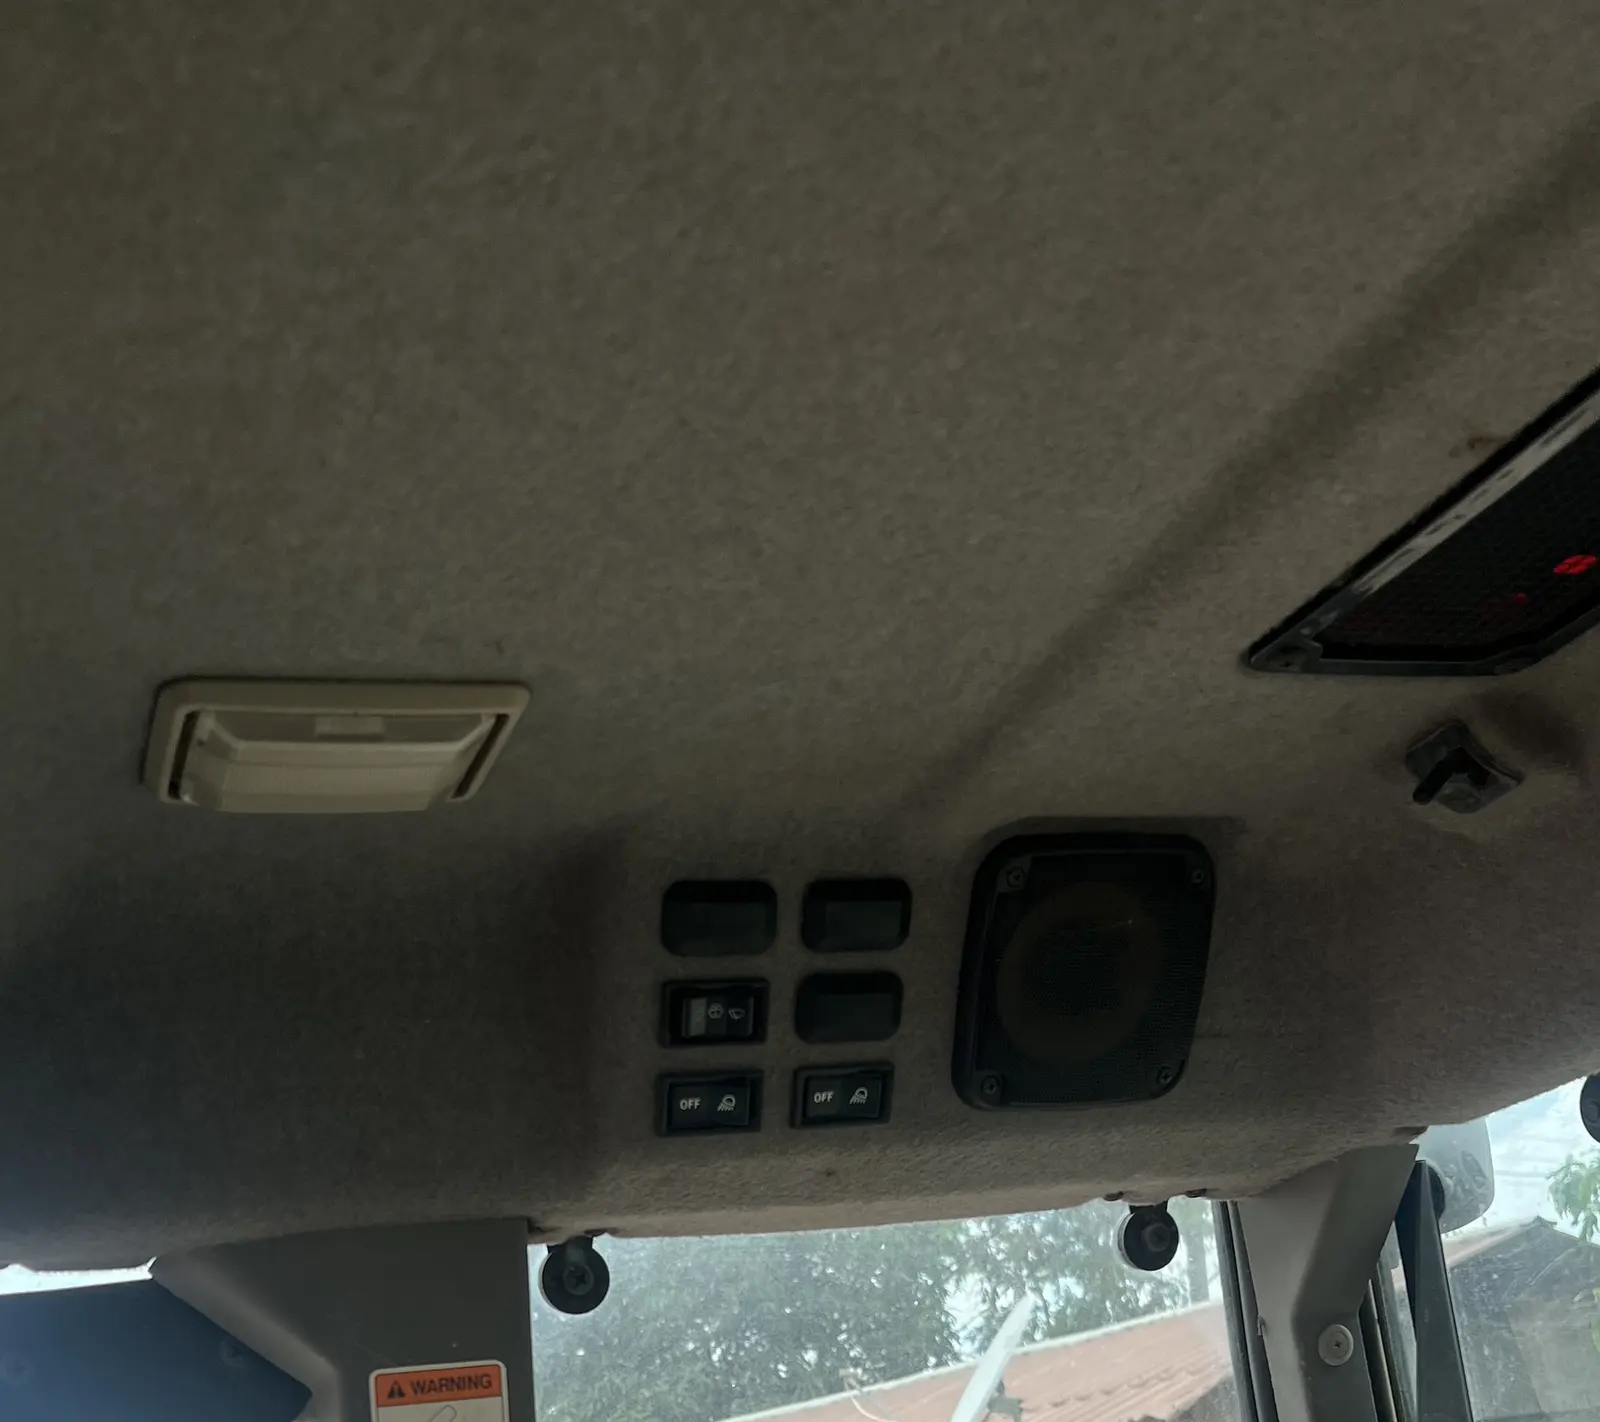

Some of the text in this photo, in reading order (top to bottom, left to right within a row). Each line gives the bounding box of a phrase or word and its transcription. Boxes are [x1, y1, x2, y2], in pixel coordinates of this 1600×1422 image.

[813, 1091, 835, 1103] OFF
[679, 1098, 700, 1110] OFF
[410, 1374, 493, 1396] WARNING
